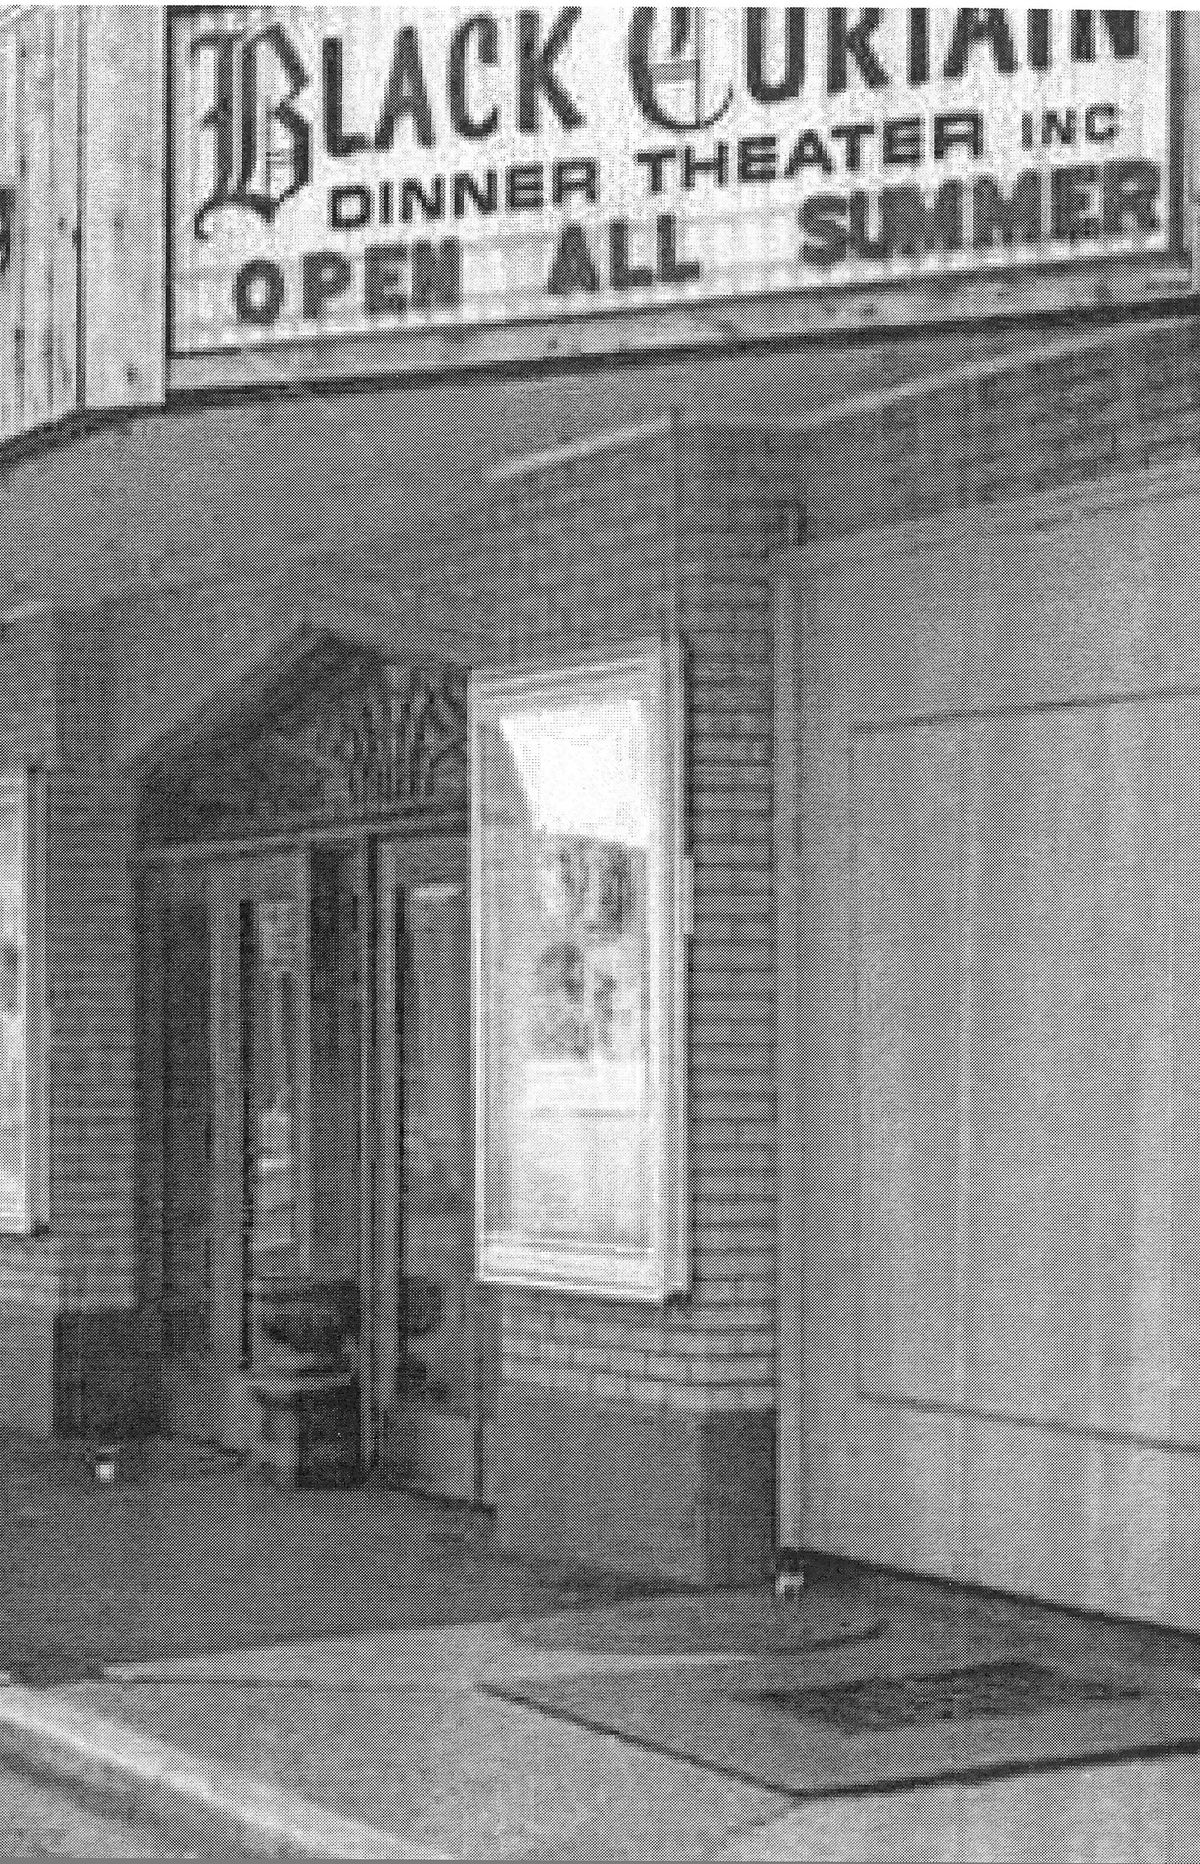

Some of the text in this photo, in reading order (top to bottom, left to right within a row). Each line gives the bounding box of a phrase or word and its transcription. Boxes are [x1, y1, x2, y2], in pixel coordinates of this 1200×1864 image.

[190, 8, 588, 239] BLACK
[329, 102, 1118, 231] DINNER THEATER INC
[234, 158, 1161, 325] OPEN ALL SUMMER
